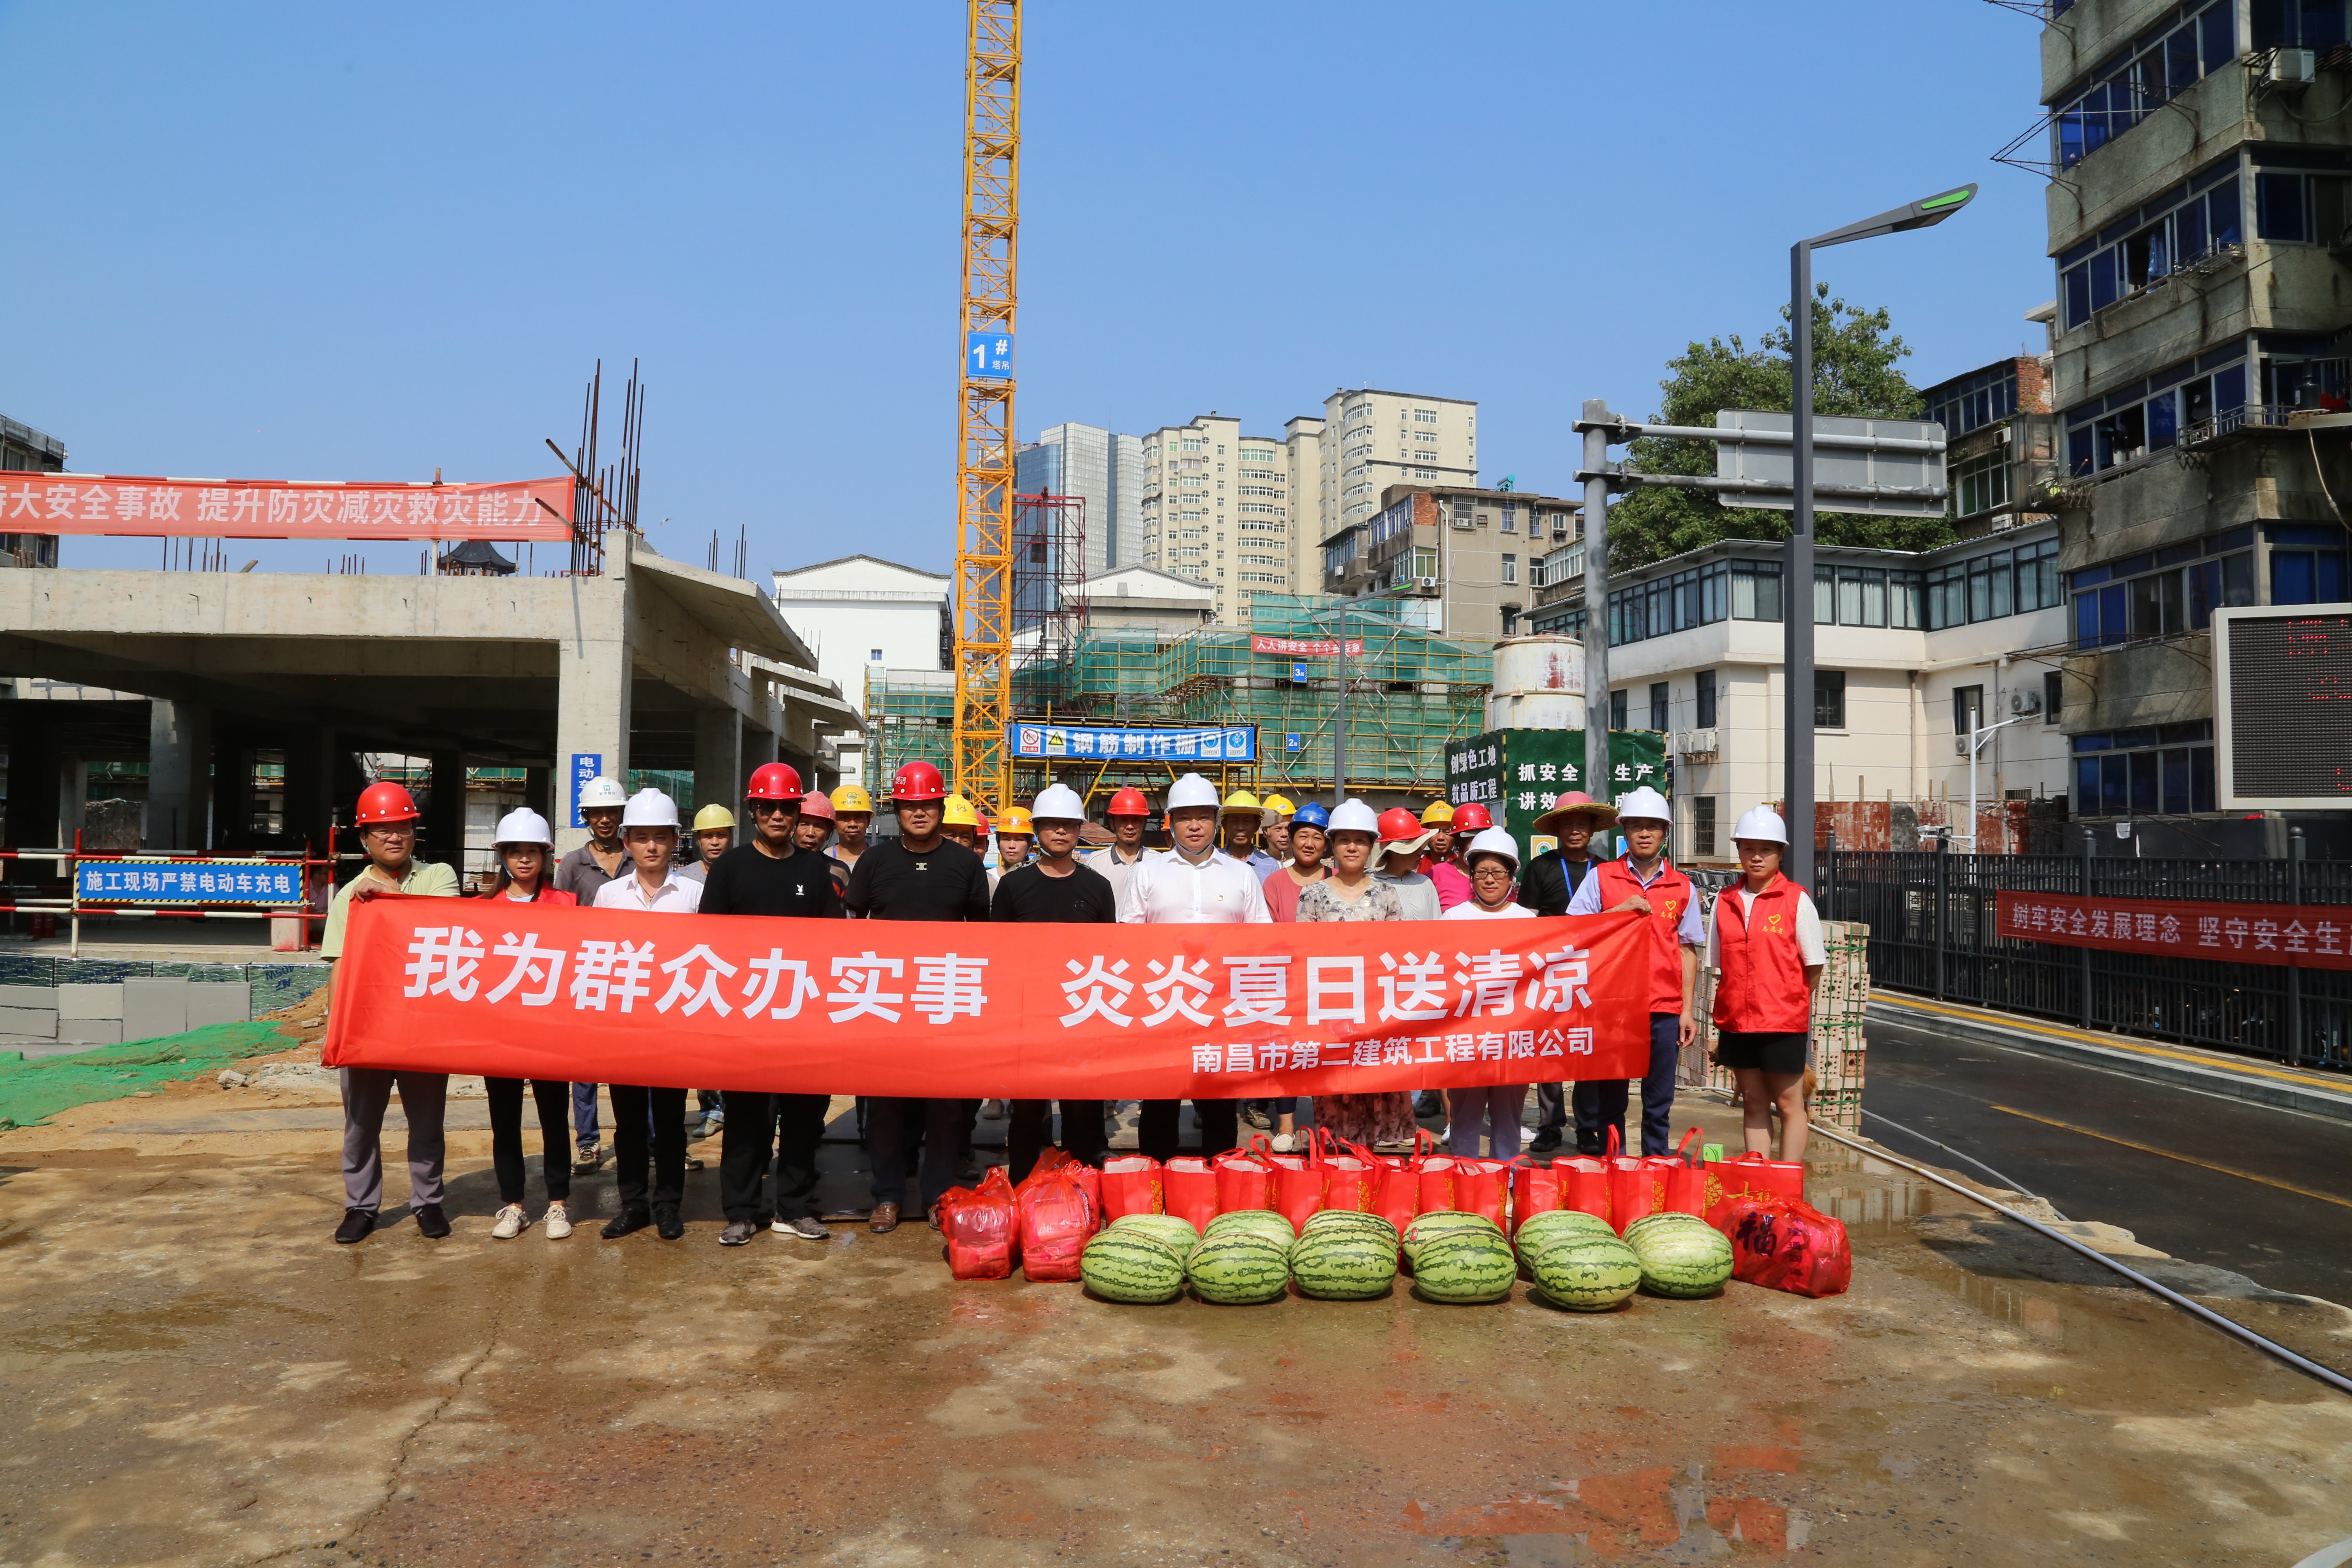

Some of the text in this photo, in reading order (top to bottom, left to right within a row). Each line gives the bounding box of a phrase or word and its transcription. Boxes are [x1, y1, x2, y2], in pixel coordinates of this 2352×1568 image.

[992, 360, 1009, 370] 塔吊
[0, 482, 544, 527] 大安全事故 提升防灾减灾救灾能力
[1256, 639, 1308, 652] 人人讲安全
[1073, 732, 1195, 756] 钢筋制作棚
[1451, 744, 1496, 774] 创绿色工地
[1518, 763, 1579, 781] 抓安全
[1451, 778, 1498, 805] 筑品质工程
[86, 871, 290, 894] 施工现场严禁电动车充电
[1761, 925, 1784, 934] 志愿者
[2013, 902, 2352, 956] 树牢安全发展理念 坚守安全生
[403, 925, 1592, 1027] 我为群众办实事 炎炎夏日送清凉
[1191, 1027, 1594, 1073] 南昌市第二建筑工程有限公司
[1736, 1211, 1777, 1257] 福
